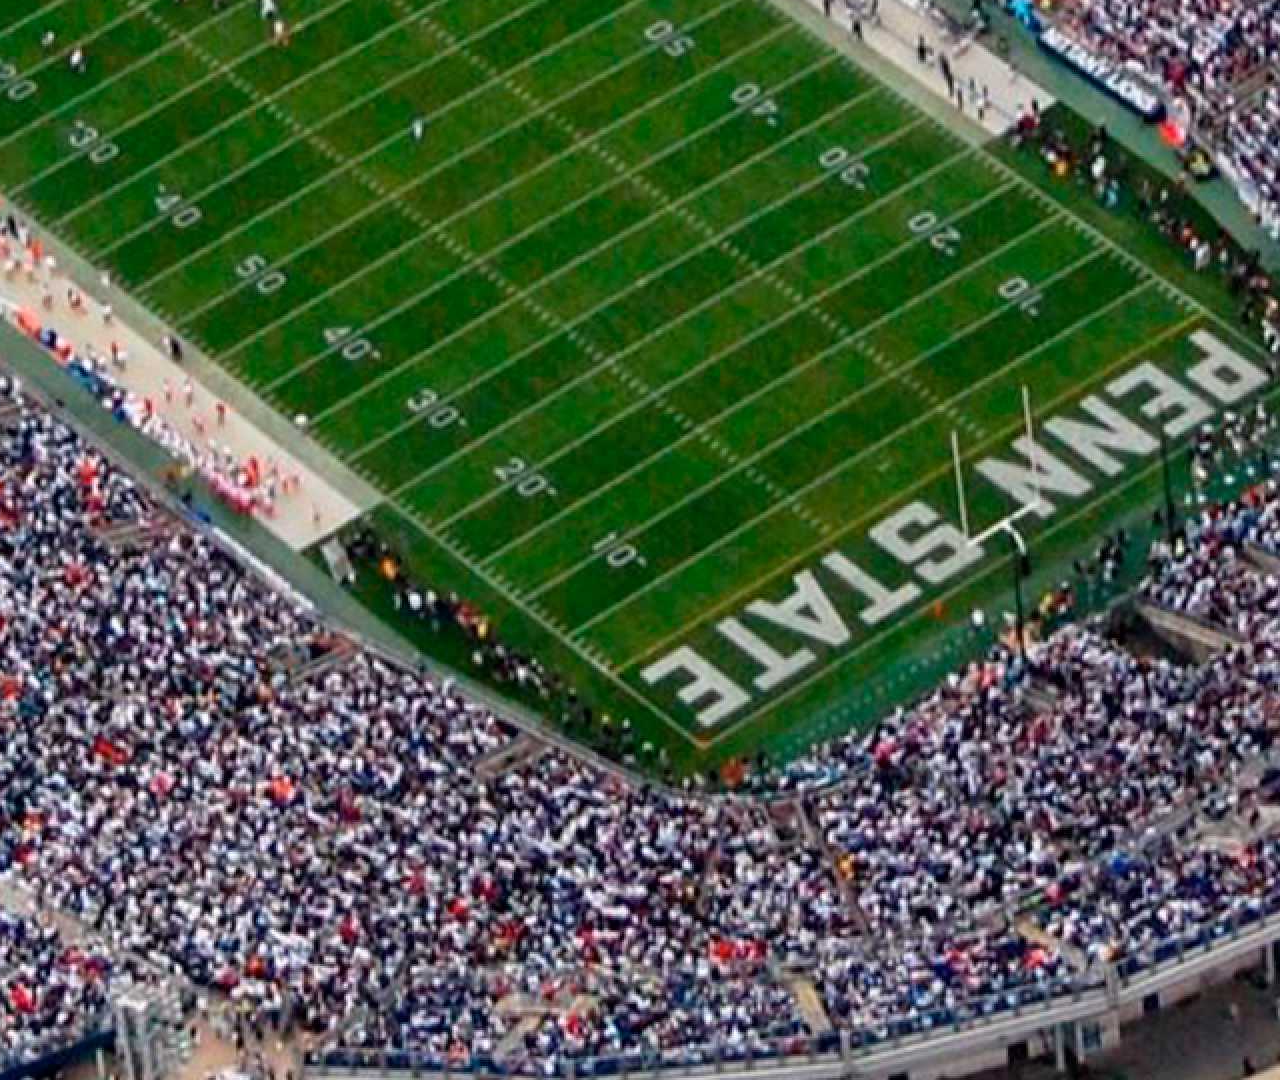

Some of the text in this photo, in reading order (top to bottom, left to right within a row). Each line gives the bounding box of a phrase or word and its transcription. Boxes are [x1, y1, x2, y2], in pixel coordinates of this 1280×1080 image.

[645, 20, 694, 56] 50
[69, 127, 119, 163] 30
[236, 255, 287, 293] 50
[324, 327, 371, 359] 40
[408, 389, 458, 428] 30
[494, 458, 548, 495] 20
[640, 329, 1271, 727] PENN STATE
[592, 532, 636, 566] 10
